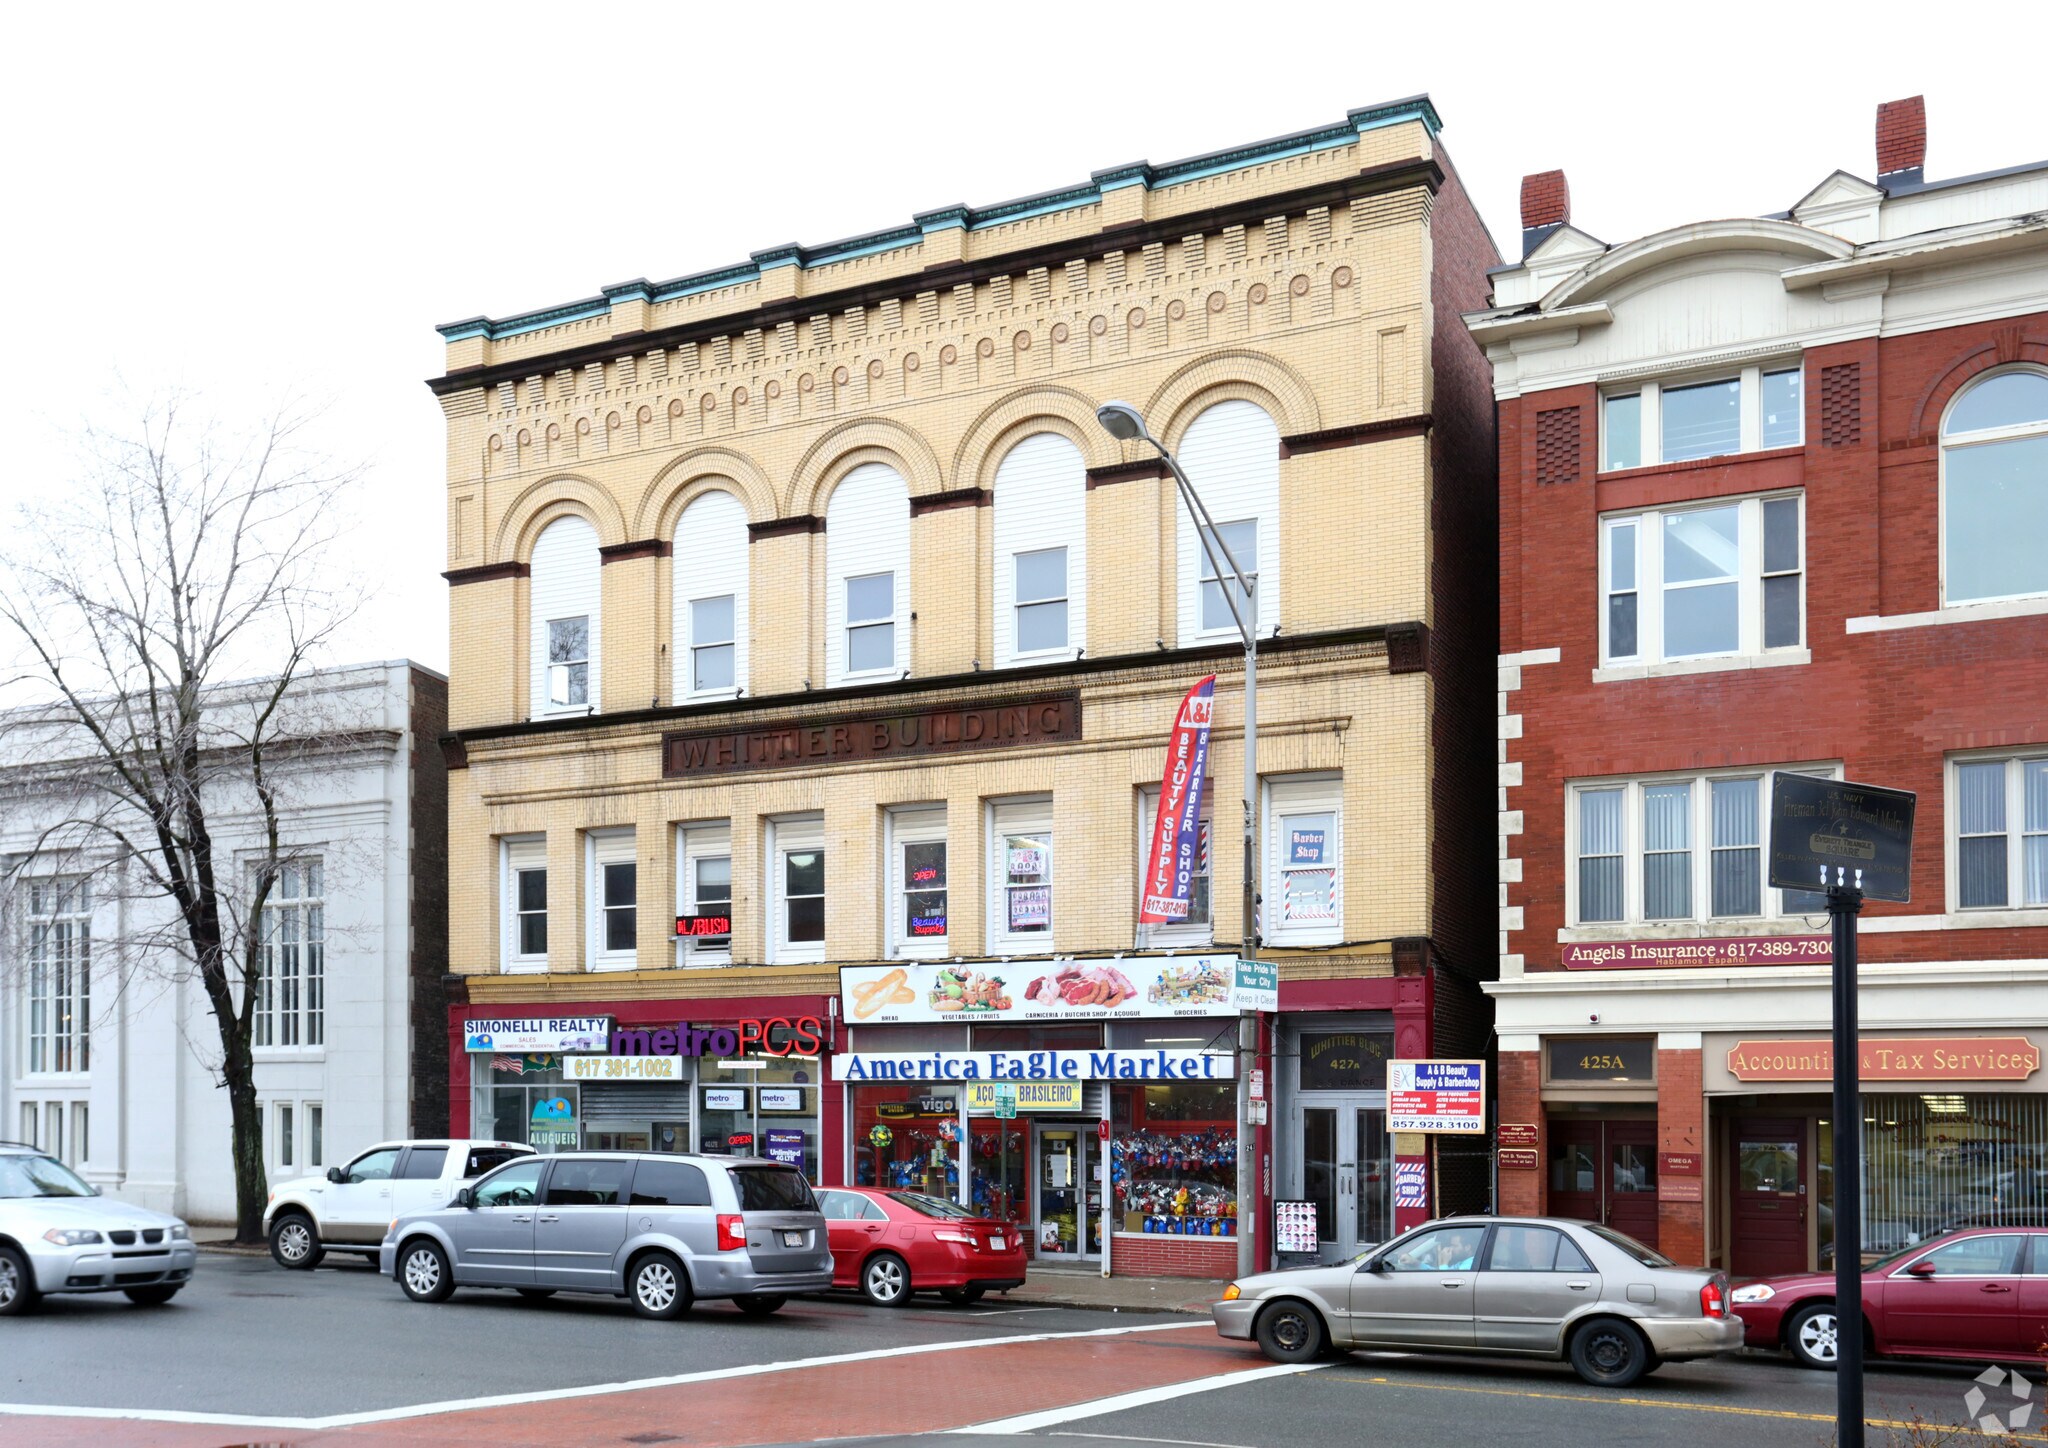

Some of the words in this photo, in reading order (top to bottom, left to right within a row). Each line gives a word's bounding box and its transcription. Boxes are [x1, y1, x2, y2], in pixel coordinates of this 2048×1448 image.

[682, 726, 853, 769] WHITTIER
[870, 703, 1062, 751] BUILDING
[1167, 732, 1190, 811] BEAUTY
[1843, 793, 1865, 804] NAVY
[1783, 795, 1816, 818] Fireman
[1850, 805, 1879, 826] Edward
[1292, 832, 1324, 843] Barber
[1154, 816, 1175, 896] SUPPLY
[1295, 846, 1319, 861] Shop
[1825, 845, 1860, 857] SQUARE
[913, 869, 937, 881] OPEN
[1176, 842, 1192, 898] SHOP
[912, 917, 946, 927] Beauty
[914, 925, 946, 935] Supply
[1570, 945, 1625, 965] Angels
[1630, 944, 1717, 960] Insurance
[1656, 957, 1703, 966] Hablamos
[1708, 956, 1748, 965] Español
[1236, 962, 1252, 973] Take
[1254, 964, 1269, 975] Pride
[1243, 975, 1257, 985] Your
[1259, 977, 1271, 989] City
[1236, 993, 1253, 1004] Keep
[1254, 994, 1259, 1003] it
[1260, 995, 1276, 1005] Clean
[1025, 1011, 1059, 1019] CARNICERIA
[1091, 1010, 1108, 1018] SHOP
[466, 1020, 543, 1033] SIMONELLI
[549, 1019, 606, 1032] REALTY
[611, 1015, 821, 1057] metroPCS
[1310, 1035, 1356, 1059] WHITTIER
[846, 1053, 979, 1080] America
[989, 1051, 1079, 1080] Eagle
[1089, 1051, 1215, 1080] Market
[1580, 1055, 1626, 1069] 425A
[1734, 1051, 1833, 1071] Accounti
[1862, 1056, 1872, 1069] &
[1876, 1049, 1925, 1070] Tax
[1933, 1049, 2034, 1070] Services
[574, 1058, 601, 1077] 617
[604, 1058, 673, 1077] 381-1002
[1427, 1065, 1433, 1075] A
[1433, 1065, 1439, 1075] &
[1440, 1065, 1445, 1075] B
[1446, 1065, 1468, 1077] Beauty
[1416, 1077, 1437, 1089] Supply
[1437, 1077, 1443, 1087] &
[1444, 1077, 1480, 1089] Barbershop
[1019, 1085, 1073, 1102] BRASILEIRO
[921, 1098, 953, 1113] vigo
[1392, 1121, 1479, 1129] 857.928.3100
[530, 1132, 577, 1145] ALUGUEIS
[728, 1134, 753, 1146] OPEN
[770, 1149, 801, 1157] Unlimited
[1400, 1173, 1422, 1185] BARBER
[1401, 1185, 1420, 1195] SHOP
